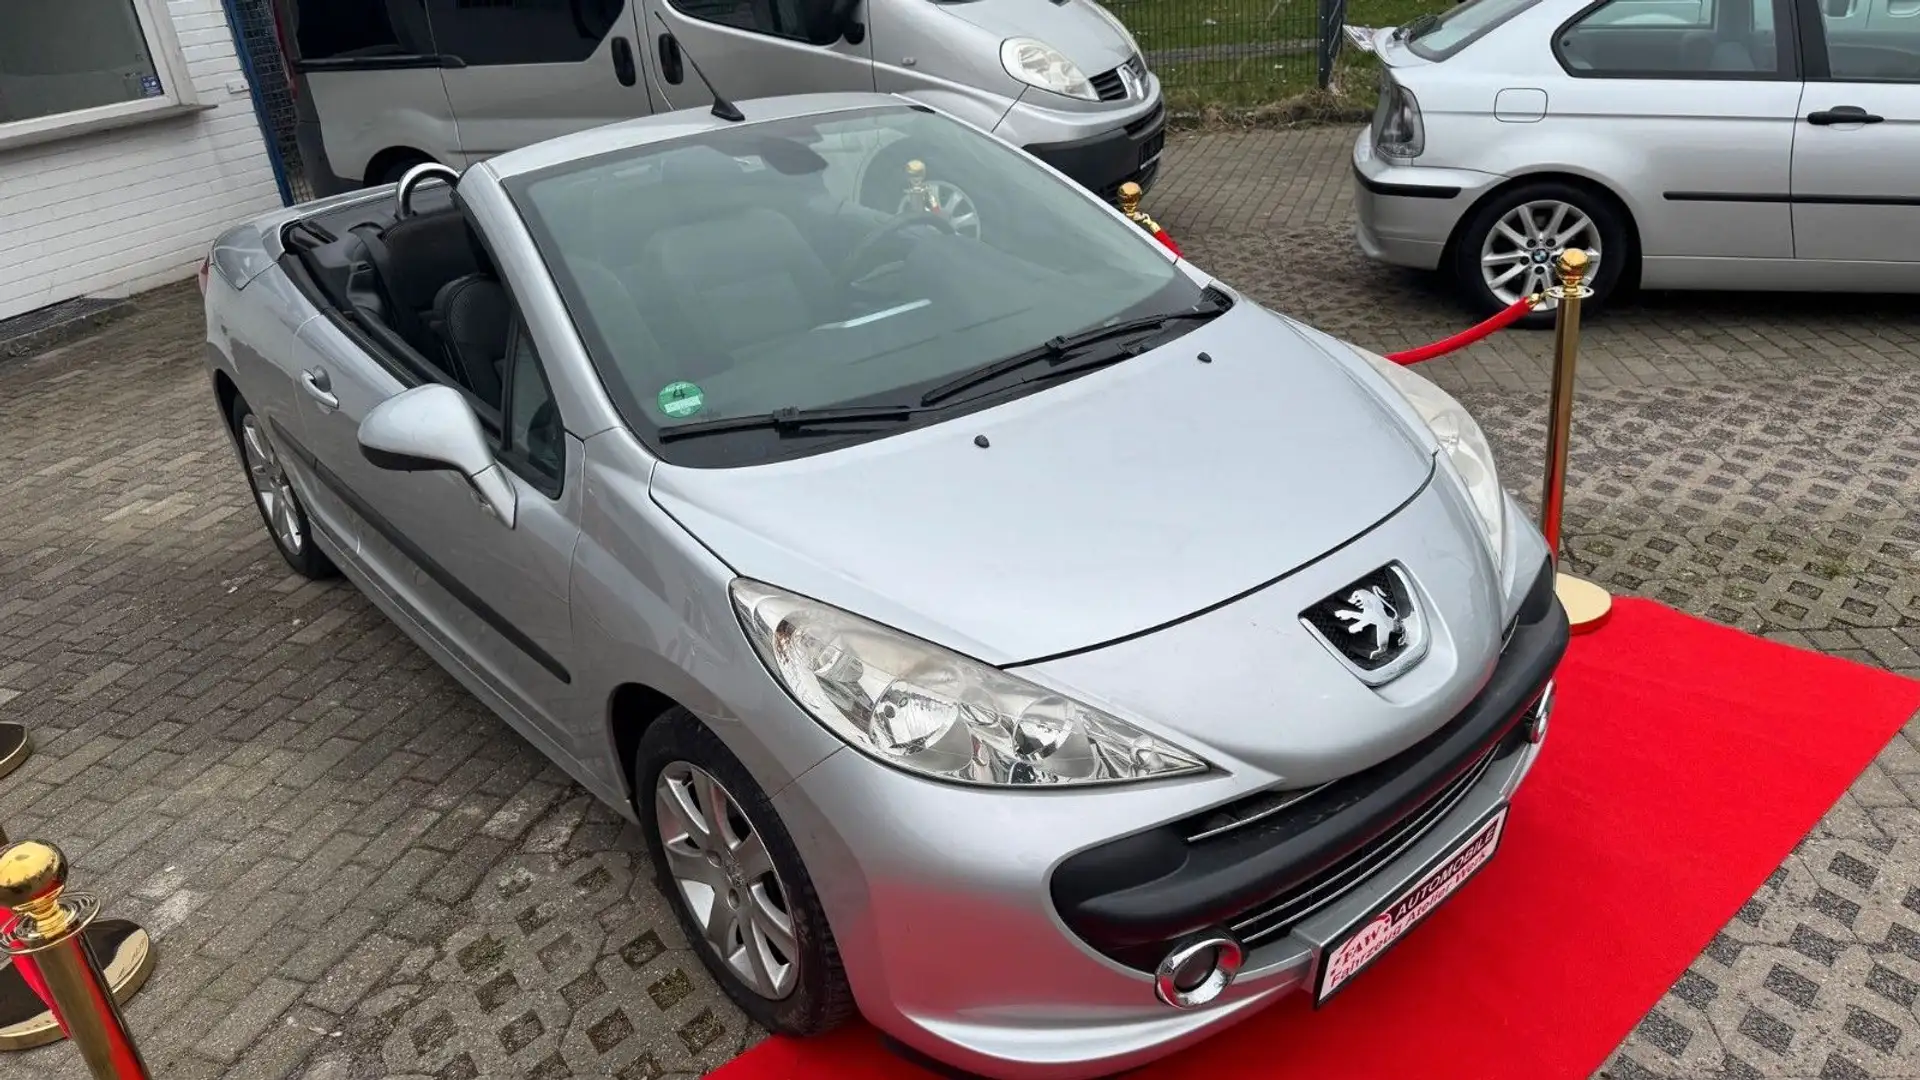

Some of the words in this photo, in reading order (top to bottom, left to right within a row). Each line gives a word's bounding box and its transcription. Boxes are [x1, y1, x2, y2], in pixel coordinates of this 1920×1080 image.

[664, 381, 675, 391] 4
[1330, 923, 1402, 988] Fahrzeug
[1405, 882, 1452, 927] Atelier
[1342, 924, 1382, 966] FAW
[1394, 825, 1496, 919] AUTOMOBILE
